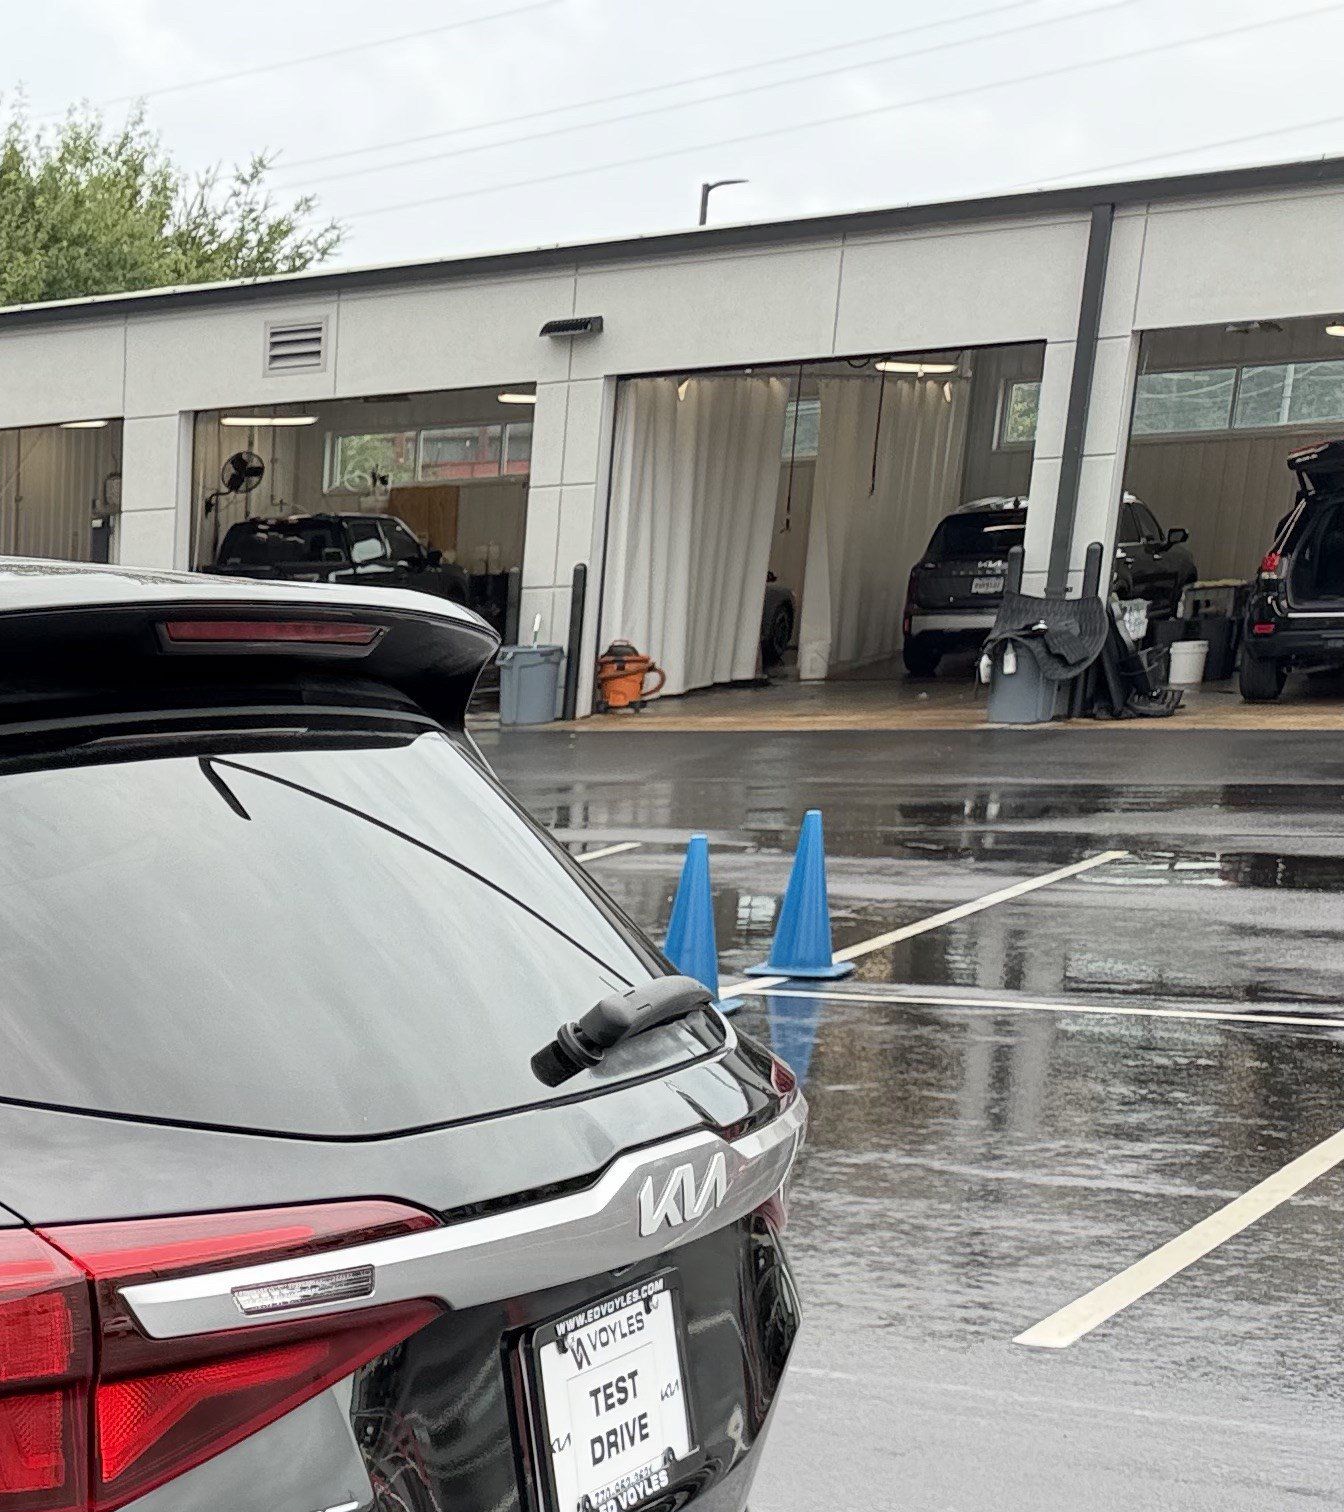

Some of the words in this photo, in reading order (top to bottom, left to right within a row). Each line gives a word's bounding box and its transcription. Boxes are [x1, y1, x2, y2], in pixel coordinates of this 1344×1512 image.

[638, 1151, 727, 1237] KIA
[555, 1277, 665, 1337] WWW.EDVOYLES.COM
[587, 1310, 646, 1353] VOYLES
[588, 1368, 640, 1418] TEST
[589, 1411, 650, 1468] DRIVE
[618, 1469, 669, 1511] VOYLES
